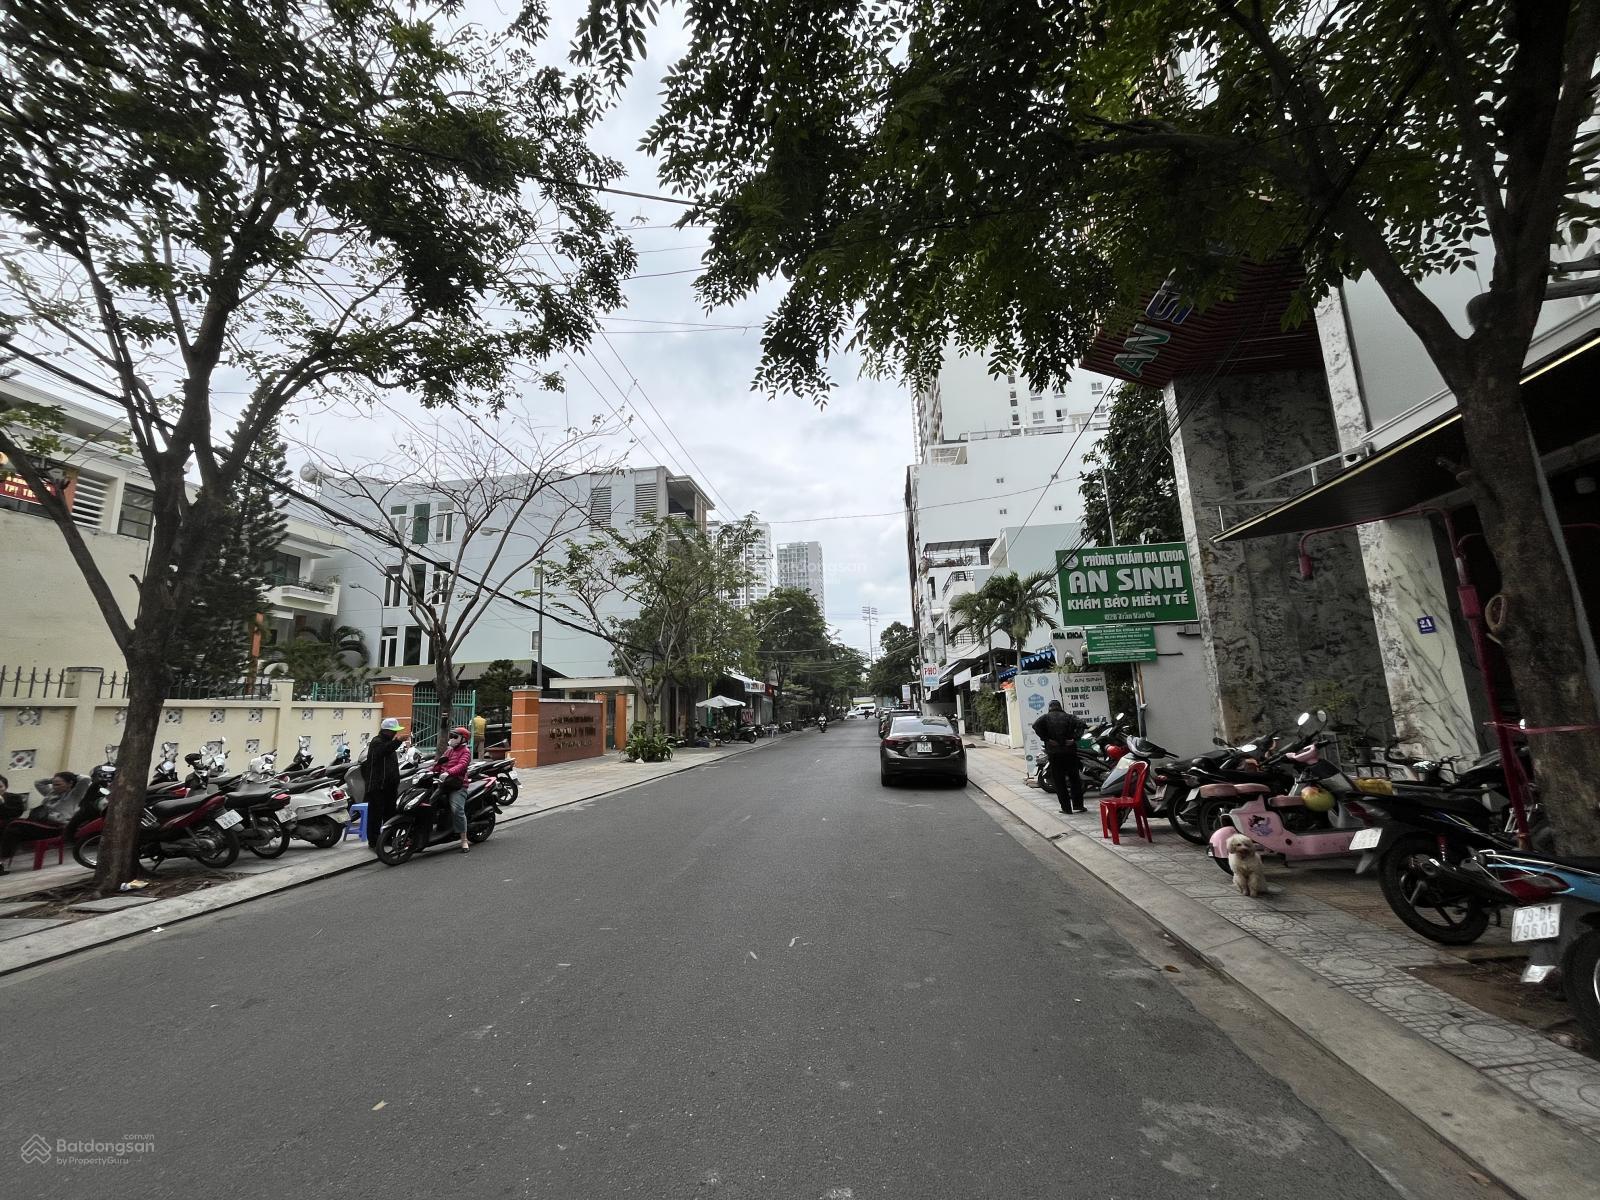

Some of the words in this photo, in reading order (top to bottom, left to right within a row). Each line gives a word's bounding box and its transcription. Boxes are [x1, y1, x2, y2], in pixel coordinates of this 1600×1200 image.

[1113, 322, 1171, 378] AN
[1083, 552, 1115, 567] PHÒNG
[1115, 549, 1144, 565] KHÁM
[1144, 551, 1159, 563] ĐA
[1159, 549, 1185, 562] KHOA
[1069, 569, 1109, 594] AN
[1116, 565, 1184, 591] SINH
[1067, 595, 1102, 611] KHÁM
[1103, 593, 1129, 609] BẢO
[1131, 591, 1161, 607] HIỂM
[1162, 594, 1171, 606] Y
[1172, 589, 1189, 605] TẾ
[1052, 631, 1066, 640] NHA
[1066, 631, 1083, 640] KHOA
